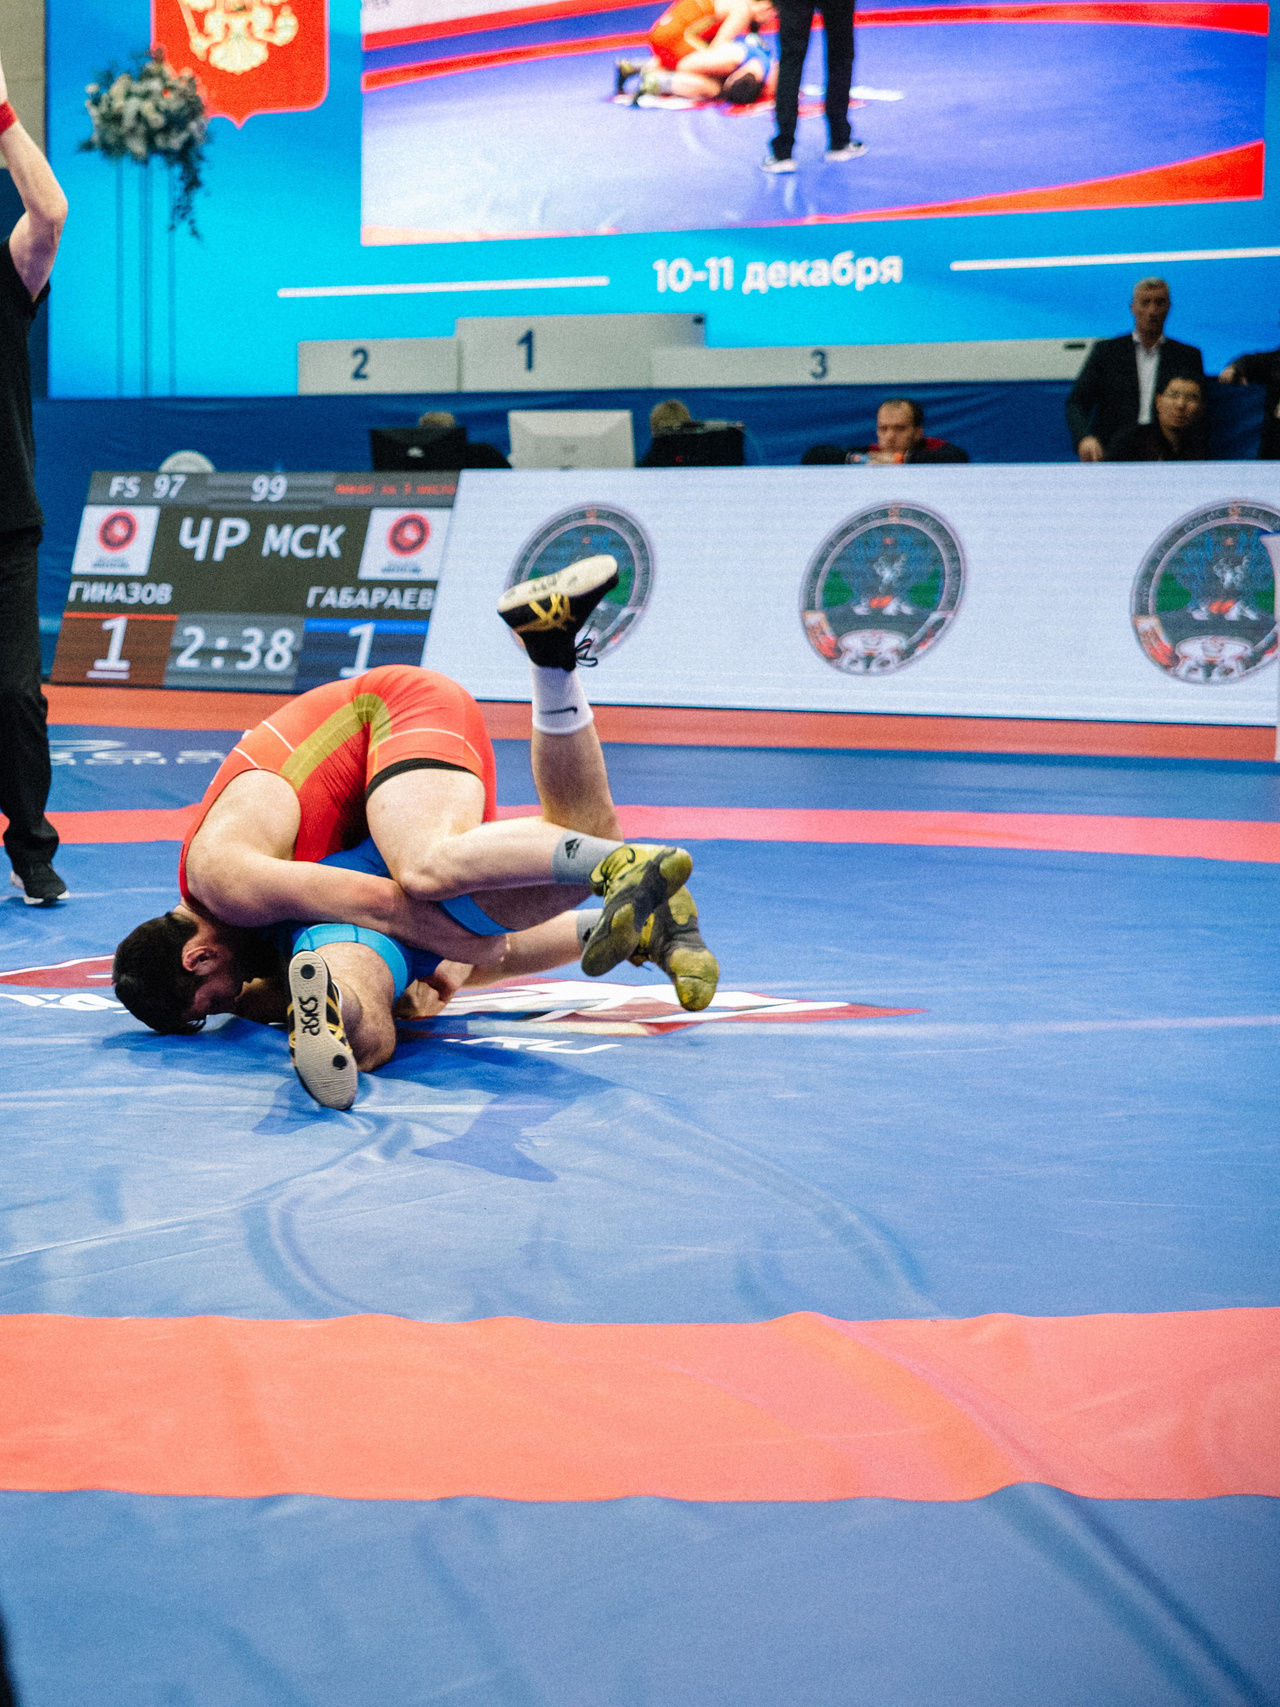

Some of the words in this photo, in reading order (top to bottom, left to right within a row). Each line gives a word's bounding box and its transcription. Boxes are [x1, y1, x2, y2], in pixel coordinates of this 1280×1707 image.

[653, 256, 734, 293] 10-11
[742, 250, 903, 294] декабря
[351, 347, 370, 380] 2
[517, 328, 534, 372] 1
[810, 349, 828, 379] 3
[109, 477, 140, 498] FS
[152, 475, 186, 499] 97
[252, 475, 288, 502] 99
[179, 517, 251, 562] ЧР
[261, 524, 346, 559] МСК
[306, 586, 435, 610] ГАБАРАЕВ
[94, 616, 131, 671] 1
[176, 625, 296, 671] 2:38
[339, 622, 376, 678] 1
